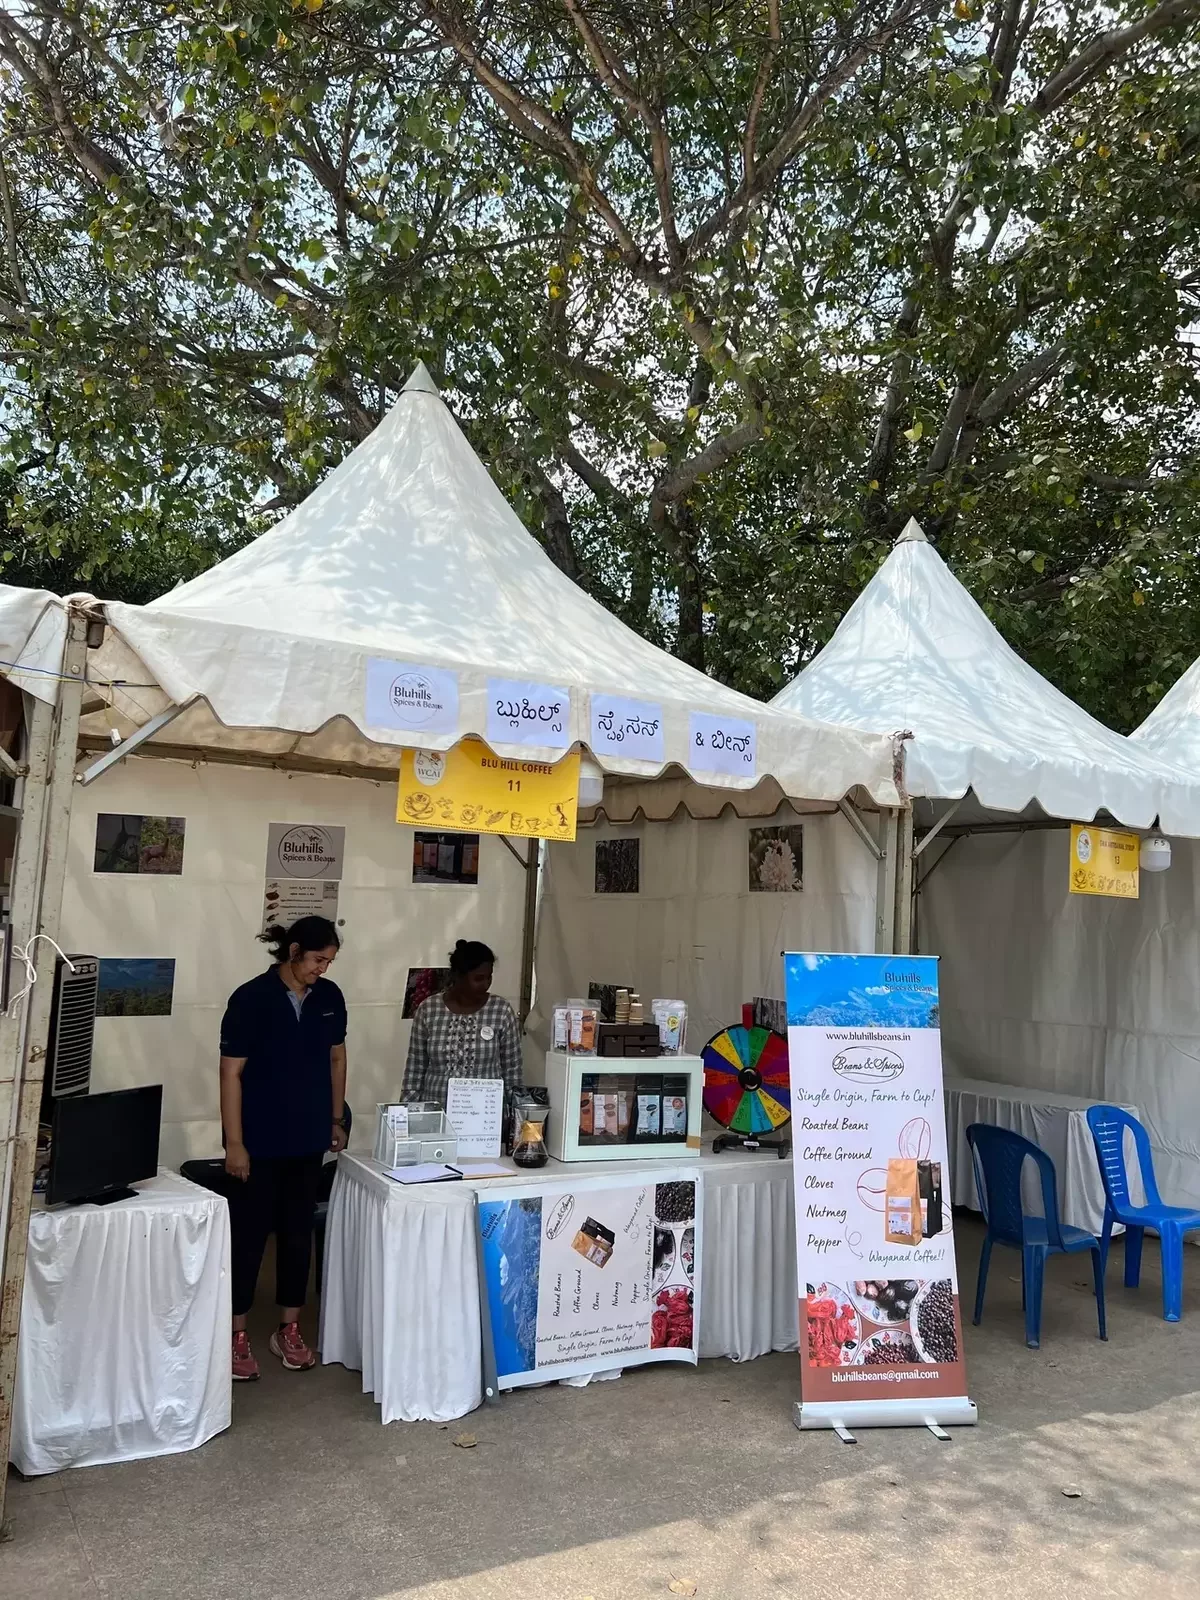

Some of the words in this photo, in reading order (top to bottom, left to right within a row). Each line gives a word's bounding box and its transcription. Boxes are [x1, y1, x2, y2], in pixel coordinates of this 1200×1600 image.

[395, 687, 432, 700] Bluhills
[394, 698, 415, 706] Spices
[423, 701, 443, 709] Beans
[696, 732, 704, 746] &
[712, 730, 752, 762] ಬೀನ್ಸ್
[481, 758, 498, 768] BLU
[501, 761, 519, 771] HILL
[522, 763, 552, 775] COFFEE
[508, 780, 520, 792] 11
[284, 842, 324, 853] Bluhills
[283, 854, 306, 862] Spices
[885, 972, 920, 983] Bluhills
[885, 984, 906, 992] Spices
[914, 984, 933, 992] Beans
[826, 1032, 911, 1041] www.bluhillsbeans.in
[833, 1056, 863, 1070] Beans
[864, 1058, 873, 1069] &
[874, 1057, 902, 1072] Spices
[797, 1088, 830, 1107] Single
[834, 1088, 867, 1107] Origin,
[872, 1090, 897, 1102] Farm
[901, 1091, 910, 1101] to
[914, 1089, 936, 1107] Cup!
[801, 1117, 838, 1130] Roasted
[842, 1118, 868, 1130] Beans
[804, 1147, 832, 1161] Coffee
[835, 1147, 872, 1160] Ground
[805, 1176, 834, 1189] Cloves
[807, 1205, 847, 1224] Nutmeg
[548, 1220, 560, 1239] Beans
[808, 1234, 842, 1253] Pepper
[869, 1250, 910, 1267] Wayanad
[914, 1250, 945, 1262] Coffee!!
[612, 1282, 622, 1306] Nutmeg
[631, 1284, 640, 1303] Pepper
[643, 1282, 653, 1302] Single
[557, 1344, 575, 1355] Single
[599, 1337, 614, 1346] Farm
[622, 1332, 636, 1343] Cup!
[538, 1353, 597, 1367] bluhillsbeans@gmail.com
[832, 1370, 939, 1382] bluhillsbeans@gmail.com
